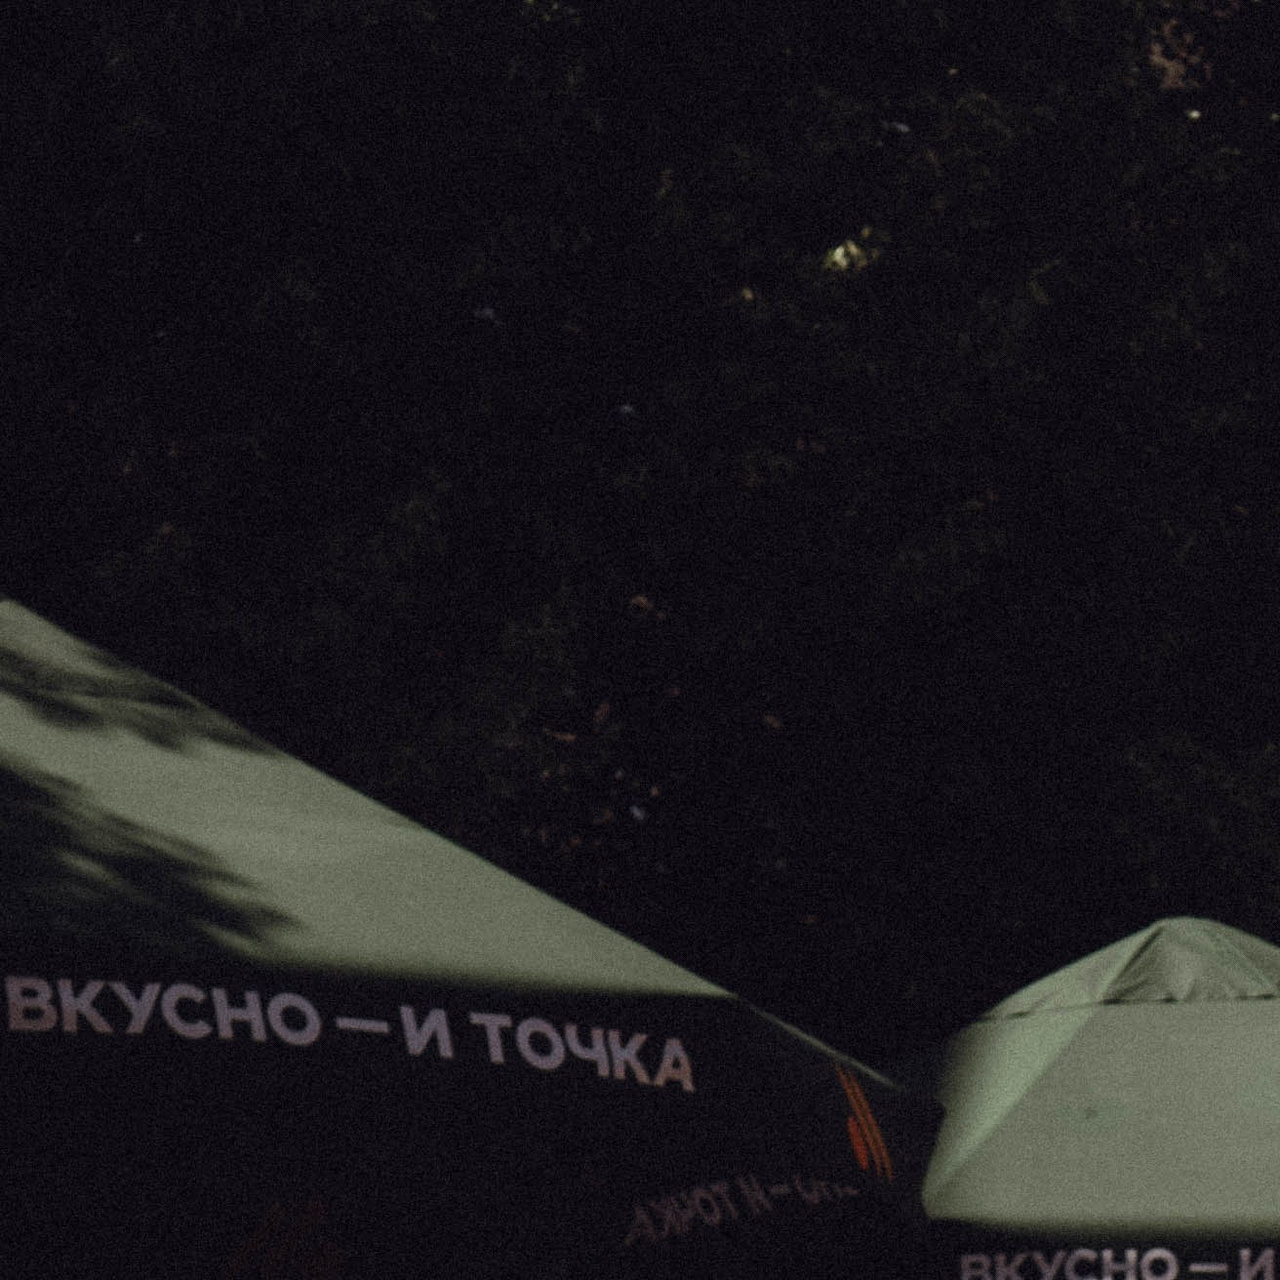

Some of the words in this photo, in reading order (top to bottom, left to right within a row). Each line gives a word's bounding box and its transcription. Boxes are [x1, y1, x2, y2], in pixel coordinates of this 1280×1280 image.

[5, 975, 322, 1046] ВКУСНО
[400, 1003, 453, 1059] И
[469, 1011, 695, 1092] ТОЧКА
